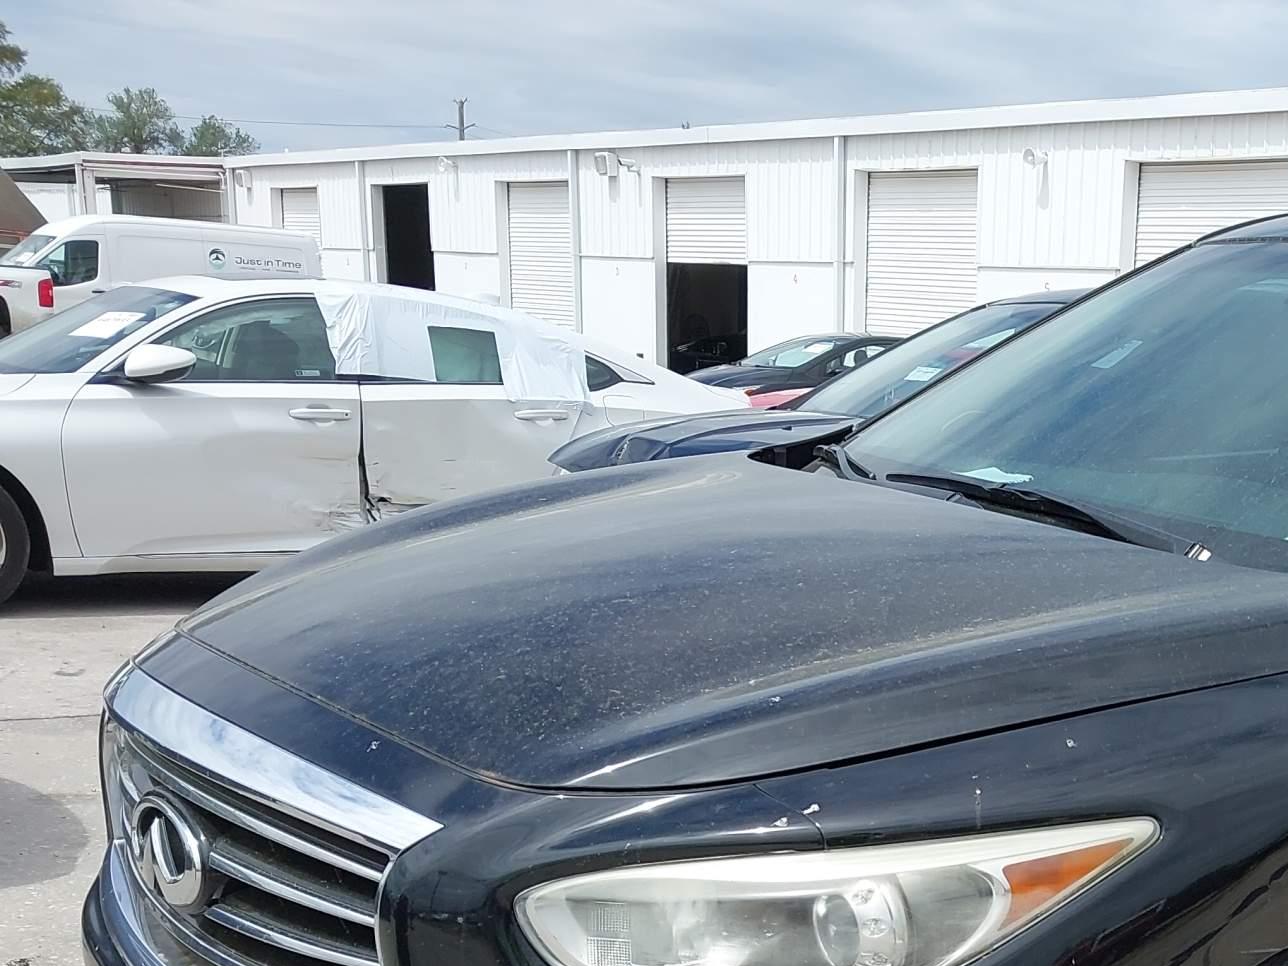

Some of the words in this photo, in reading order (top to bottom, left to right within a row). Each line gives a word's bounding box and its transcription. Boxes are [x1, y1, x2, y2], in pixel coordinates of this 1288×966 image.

[234, 256, 262, 266] Just
[264, 259, 273, 267] in
[274, 260, 302, 269] Time
